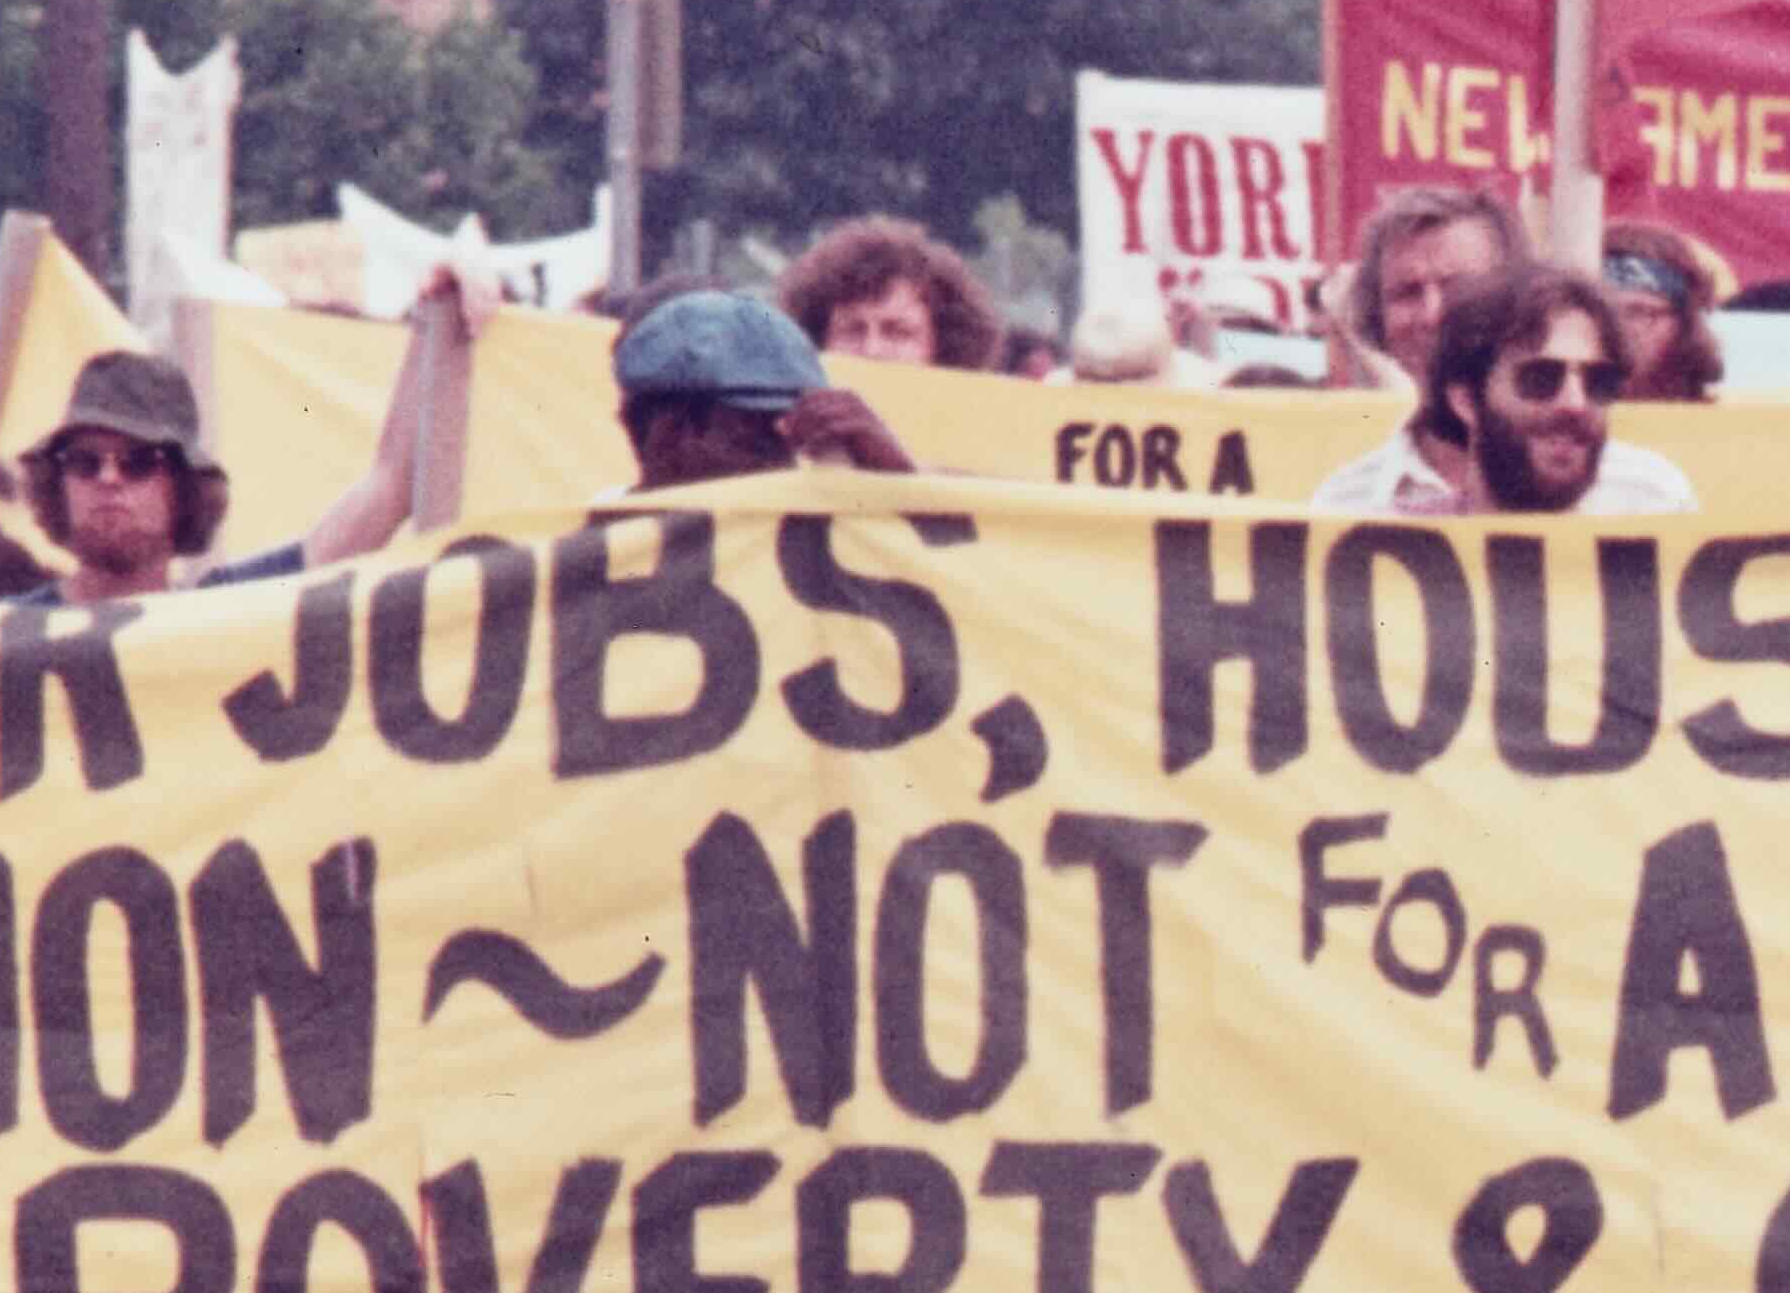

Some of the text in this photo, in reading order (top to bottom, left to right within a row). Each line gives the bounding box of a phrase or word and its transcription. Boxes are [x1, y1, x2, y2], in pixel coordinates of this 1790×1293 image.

[1055, 421, 1255, 496] FOR A
[223, 510, 1046, 802] JOBS,
[684, 810, 1205, 1130] NOT
[1299, 815, 1555, 1075] FOR
[1608, 824, 1773, 1120] A
